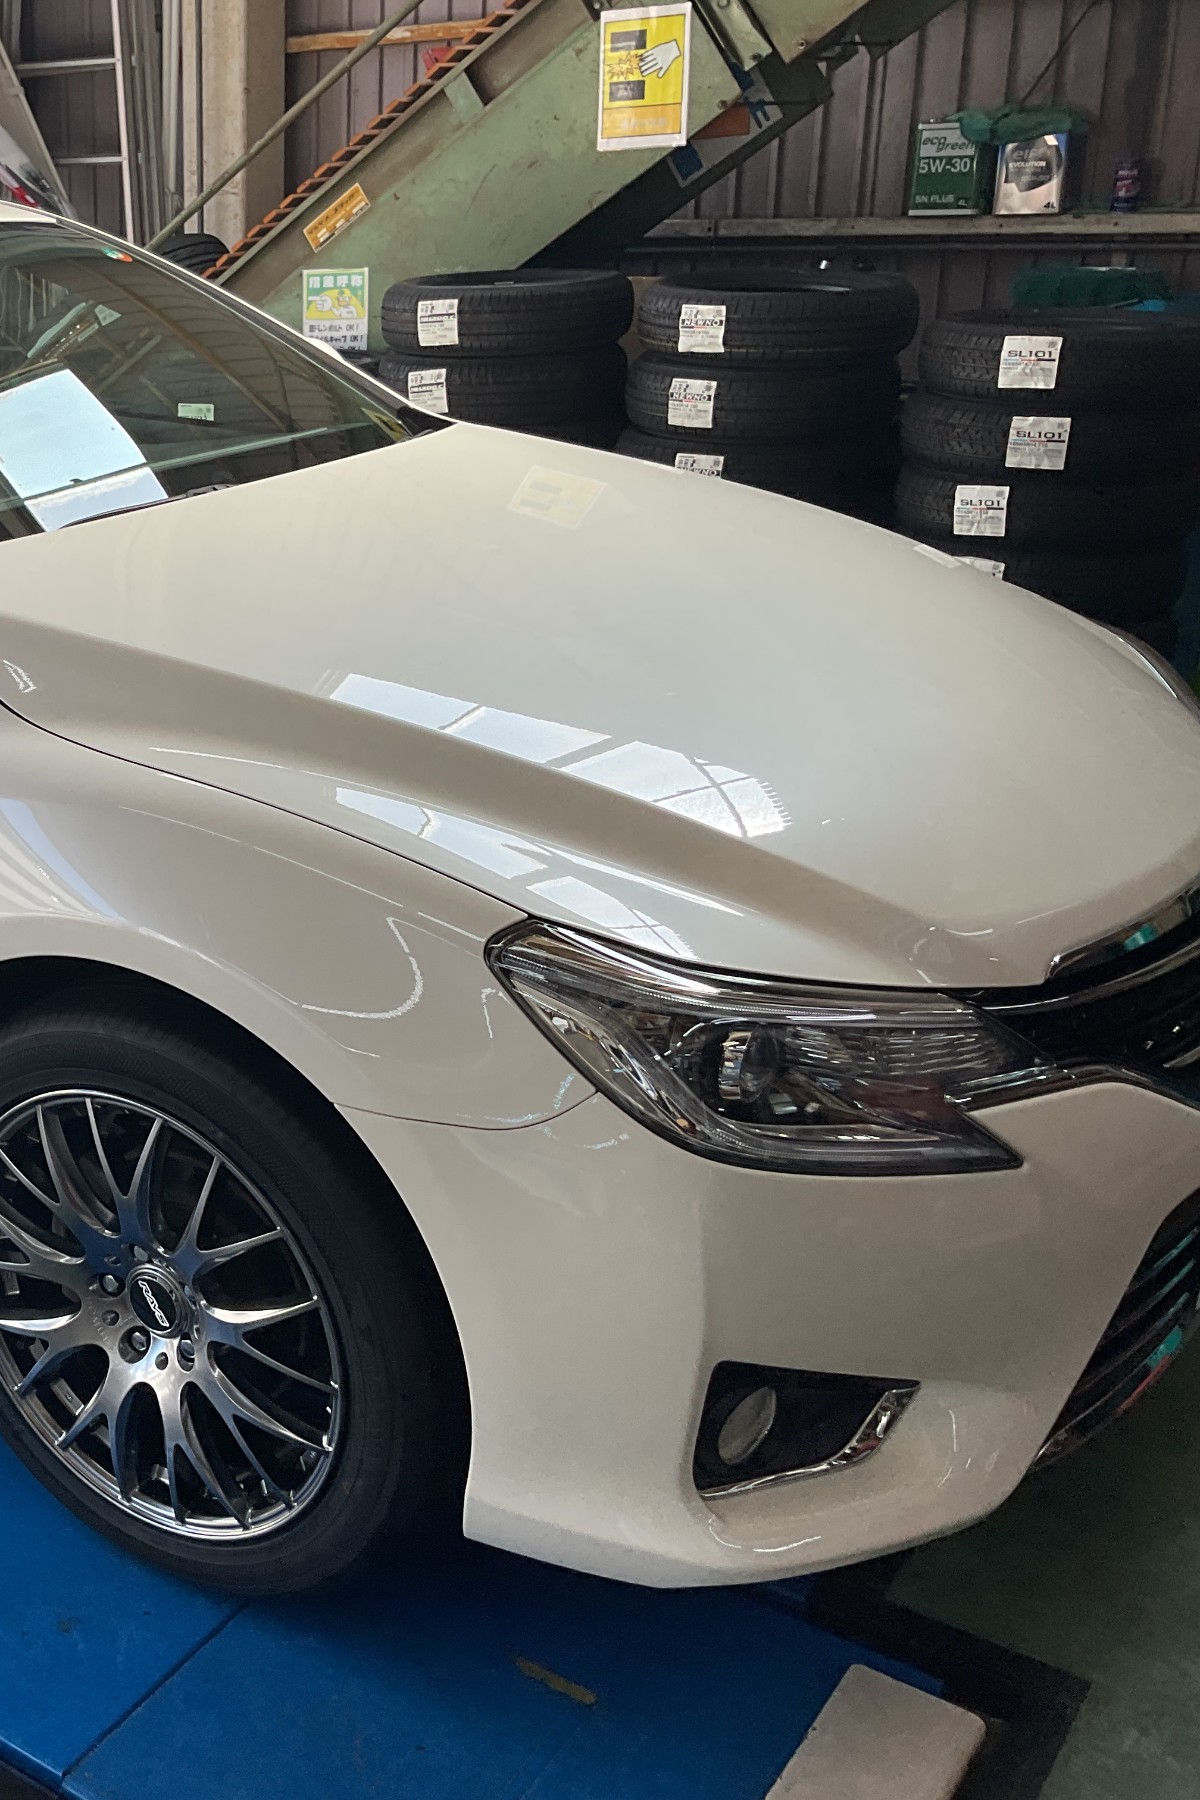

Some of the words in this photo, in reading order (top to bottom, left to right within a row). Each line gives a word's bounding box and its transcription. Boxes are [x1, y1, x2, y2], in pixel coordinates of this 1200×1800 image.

[918, 157, 971, 174] 5W-30
[1008, 160, 1047, 168] EVOLUTION
[915, 195, 929, 204] SN
[930, 194, 955, 203] PLUS
[1043, 201, 1057, 209] 4L
[683, 318, 720, 326] NEWNO
[1007, 350, 1053, 358] SL101
[672, 391, 709, 401] NEWNO
[1016, 430, 1063, 439] SL101
[960, 499, 1001, 507] SL101
[137, 1279, 170, 1328] RAYS
